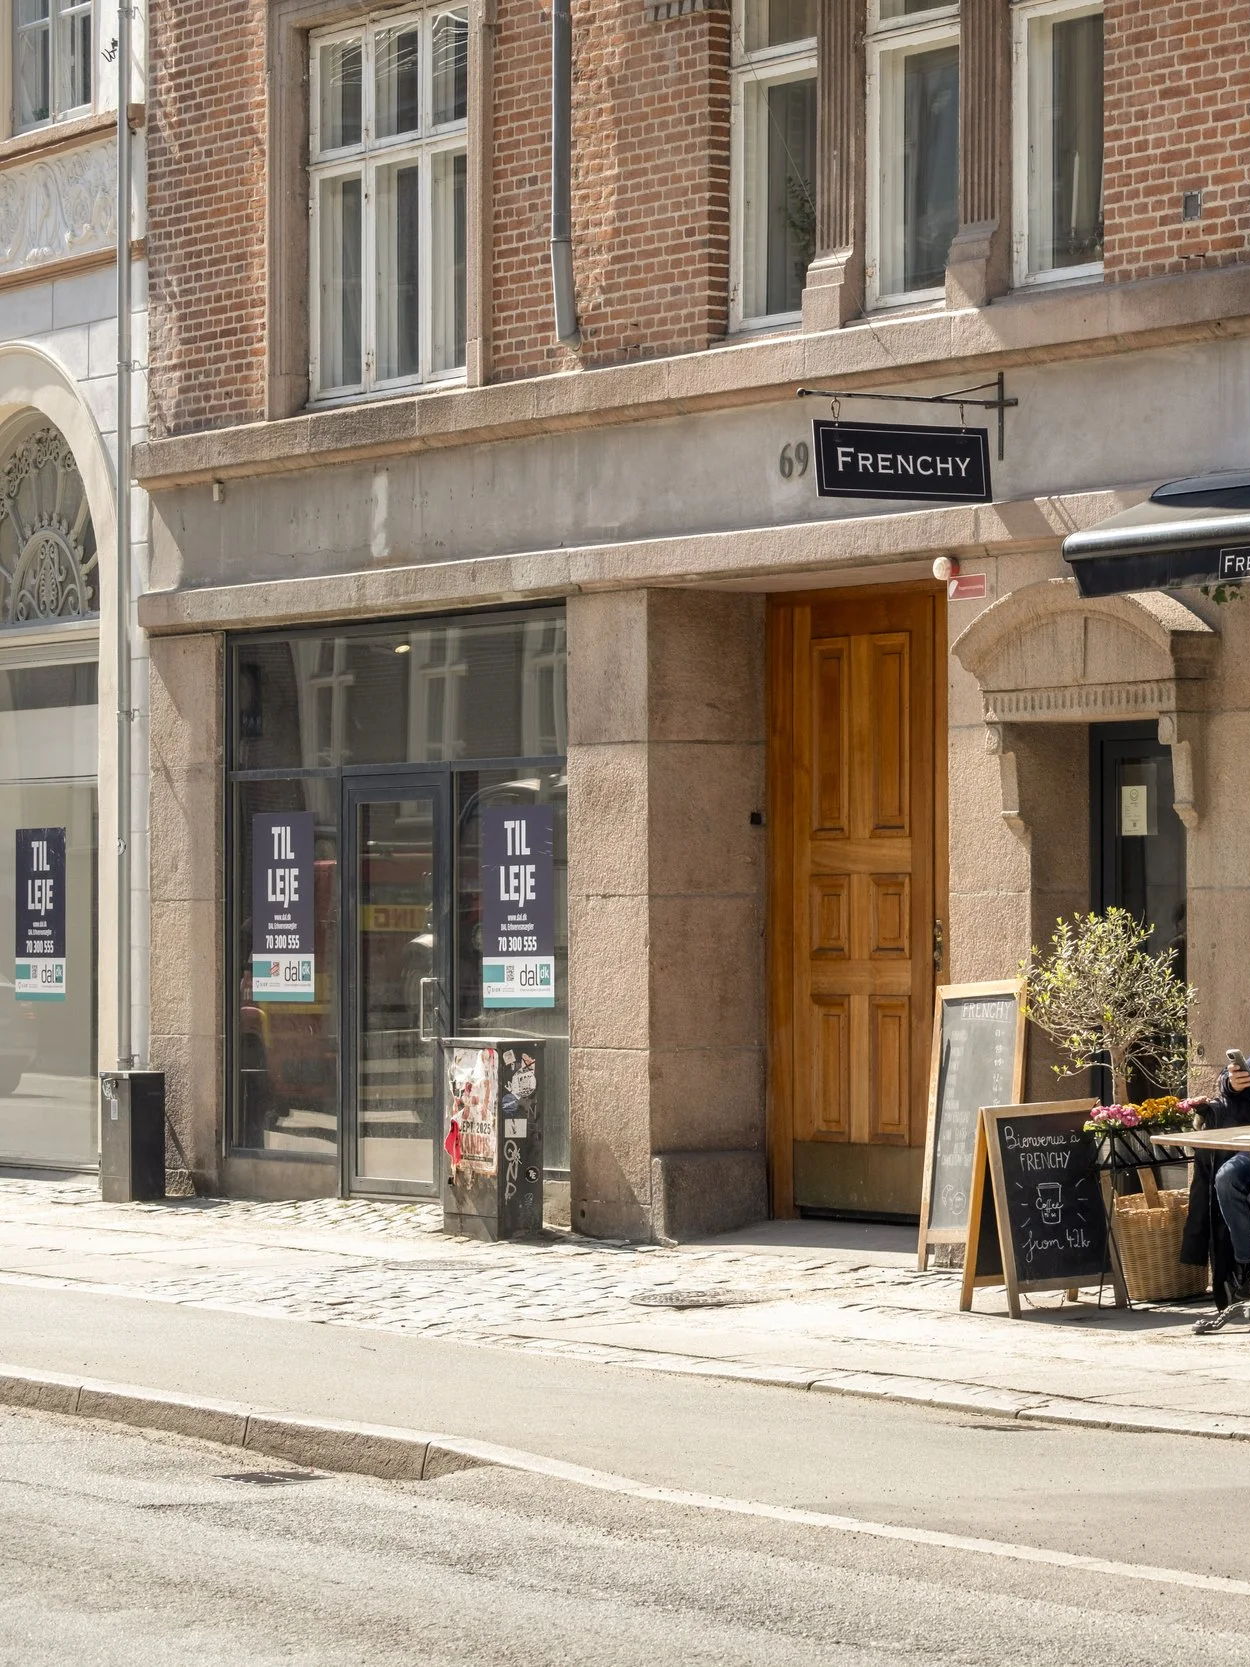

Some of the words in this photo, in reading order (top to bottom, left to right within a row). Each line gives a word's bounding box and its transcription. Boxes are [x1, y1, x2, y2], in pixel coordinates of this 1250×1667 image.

[779, 442, 809, 479] 69
[836, 447, 971, 477] FRENCHY
[272, 826, 295, 860] TIL
[504, 820, 530, 856] TIL
[31, 840, 50, 871] TIL
[28, 879, 53, 916] LEJE
[267, 868, 299, 908] LEJE
[500, 864, 536, 907] LEJE
[26, 940, 33, 953] 70
[33, 940, 43, 953] 300
[44, 940, 54, 953] 555
[265, 935, 274, 949] 70
[275, 935, 287, 949] 300
[288, 935, 300, 949] 555
[498, 936, 507, 951] 70
[508, 936, 522, 951] 300
[523, 936, 537, 951] 555
[962, 1001, 1012, 1020] FRENCHY
[476, 1122, 491, 1134] 2025
[1004, 1126, 1067, 1149] Bienvenue
[1020, 1151, 1071, 1172] FRENCHY
[1036, 1197, 1064, 1213] Coffee
[1022, 1230, 1064, 1263] from
